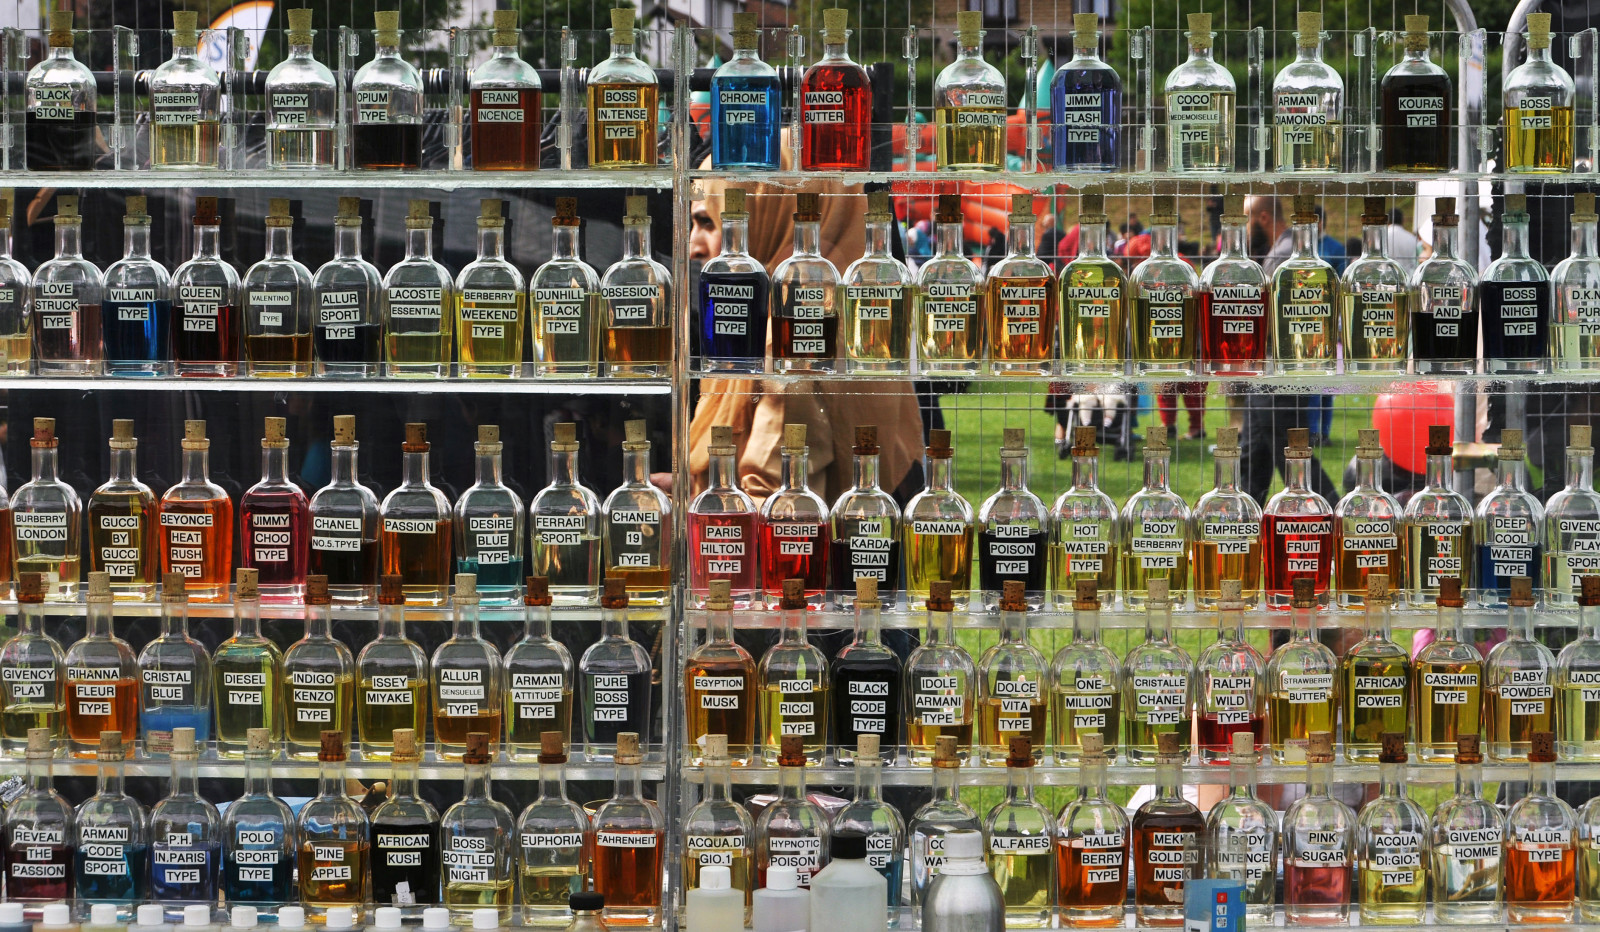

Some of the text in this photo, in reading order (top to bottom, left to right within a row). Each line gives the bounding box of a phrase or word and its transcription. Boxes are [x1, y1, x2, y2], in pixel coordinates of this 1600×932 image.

[36, 91, 70, 100] BLACK
[273, 96, 308, 105] HAPPY
[482, 93, 518, 102] FRANK
[606, 92, 636, 101] BOSS
[721, 93, 765, 103] CHROME
[806, 94, 842, 103] MANGO
[1067, 96, 1100, 105] JIMMY
[1177, 95, 1209, 104] COCO
[1279, 96, 1317, 106] ARMANI
[1400, 99, 1443, 108] KOURAS
[1521, 99, 1550, 109] BOSS
[36, 108, 73, 118] STONE
[479, 111, 523, 121] INCENCE
[805, 112, 843, 121] BUTTER
[1066, 113, 1100, 122] FLASH
[43, 284, 71, 294] LOVE
[182, 289, 220, 299] QUEEN
[389, 289, 440, 299] LACOSTE
[709, 287, 753, 297] ARMANI
[847, 288, 902, 298] ETERNITY
[930, 286, 969, 296] GUILTY
[1214, 288, 1260, 298] VANILLA
[1292, 289, 1321, 299] LADY
[1434, 288, 1459, 298] FIRE
[1505, 289, 1536, 299] BOSS
[111, 291, 152, 300] VILLAIN
[323, 294, 357, 303] ALLUR
[465, 291, 513, 300] BERBERRY
[536, 290, 583, 300] DUNHILL
[795, 290, 823, 300] MISS
[1363, 293, 1392, 303] SEAN
[36, 301, 78, 311] STRUCK
[186, 304, 216, 314] LATIF
[543, 306, 580, 315] BLACK
[716, 305, 747, 315] CODE
[926, 303, 975, 313] INTENCE
[1213, 305, 1263, 315] FANTASY
[1284, 305, 1328, 315] MILLION
[321, 310, 358, 320] SPORT
[462, 310, 517, 320] WEEKEND
[1151, 309, 1182, 318] BOSS
[1363, 310, 1394, 320] JOHN
[1436, 307, 1460, 317] AND
[1502, 306, 1537, 317] NIHGT
[795, 325, 822, 334] DIOR
[1438, 325, 1456, 335] ICE
[16, 514, 65, 523] BURBERRY
[102, 517, 138, 527] GUCCI
[161, 514, 212, 525] BEYONCE
[254, 516, 288, 526] JIMMY
[536, 517, 584, 527] FERRARI
[613, 512, 658, 522] CHANEL
[315, 519, 358, 530] CHANEL
[385, 520, 433, 532] PASSION
[471, 519, 512, 529] DESIRE
[860, 523, 880, 533] KIM
[915, 523, 960, 533] BANANA
[1144, 523, 1176, 533] BODY
[1277, 523, 1331, 533] JAMAICAN
[1356, 523, 1389, 533] COCO
[1496, 519, 1526, 529] DEEP
[18, 528, 65, 539] LONDON
[707, 527, 740, 537] PARIS
[775, 525, 817, 535] DESIRE
[997, 526, 1028, 536] PURE
[1074, 526, 1097, 535] HOT
[1206, 524, 1258, 535] EMPRESS
[1429, 525, 1461, 535] ROCK
[113, 533, 128, 543] BY
[172, 532, 200, 542] HEAT
[255, 533, 289, 543] CHOO
[478, 536, 507, 546] BLUE
[542, 533, 579, 543] SPORT
[628, 533, 640, 542] 19
[1496, 534, 1527, 544] COOL
[702, 544, 742, 554] HILTON
[851, 539, 889, 549] KARDA
[991, 544, 1034, 554] POISON
[1066, 543, 1105, 552] WATER
[1134, 540, 1183, 549] BERBERRY
[1288, 542, 1320, 552] FRUIT
[1344, 539, 1397, 549] CHANNEL
[103, 549, 139, 559] GUCCI
[172, 549, 202, 560] RUSH
[852, 554, 887, 564] SHIAN
[1492, 549, 1531, 559] WATER
[1429, 559, 1460, 569] ROSE
[3, 670, 54, 679] GIVENCY
[69, 669, 118, 679] RIHANNA
[143, 672, 190, 682] CRISTAL
[225, 674, 265, 684] DIESEL
[294, 673, 334, 684] INDIGO
[442, 671, 479, 681] ALLUR
[1514, 671, 1543, 682] BABY
[373, 677, 406, 687] ISSEY
[516, 675, 560, 686] ARMANI
[595, 677, 627, 687] PURE
[695, 679, 742, 689] EGYPTION
[922, 678, 957, 688] IDOLE
[1077, 679, 1102, 689] ONE
[1135, 677, 1185, 687] CRISTALLE
[1213, 678, 1251, 689] RALPH
[1284, 676, 1332, 686] STRAWBERRY
[1425, 674, 1477, 685] CASHMIR
[14, 686, 42, 696] PLAY
[78, 686, 115, 696] FLEUR
[781, 681, 812, 691] RICCI
[849, 683, 887, 693] BLACK
[997, 682, 1036, 692] DOLCE
[153, 688, 181, 698] BLUE
[294, 691, 333, 701] KENZO
[515, 689, 560, 700] ATTITUDE
[1289, 691, 1326, 701] BUTTER
[1502, 686, 1551, 697] POWDER
[368, 693, 410, 703] MIYAKE
[595, 693, 627, 703] BOSS
[703, 697, 736, 707] MUSK
[916, 696, 961, 706] ARMANI
[1066, 697, 1111, 707] MILLION
[1139, 694, 1185, 705] CHANEL
[1215, 695, 1245, 705] WILD
[1359, 696, 1401, 706] POWER
[852, 702, 884, 712] CODE
[1003, 701, 1028, 711] VITA
[15, 831, 61, 841] REVEAL
[83, 829, 127, 839] ARMANI
[241, 832, 273, 842] POLO
[1309, 833, 1336, 843] PINK
[1450, 831, 1500, 843] GIVENCY
[378, 836, 429, 846] AFRICAN
[453, 839, 484, 849] BOSS
[521, 834, 582, 846] EUPHORIA
[597, 834, 656, 845] FAHRENHEIT
[1084, 835, 1120, 846] HALLE
[1377, 836, 1417, 847] ACQUA
[28, 848, 52, 858] THE
[88, 846, 121, 857] CODE
[316, 849, 343, 859] PINE
[1455, 847, 1498, 858] HOMME
[237, 852, 277, 862] SPORT
[388, 854, 420, 864] KUSH
[1082, 853, 1122, 864] BERRY
[1303, 852, 1343, 862] SUGAR
[13, 865, 64, 876] PASSION
[86, 863, 125, 873] SPORT
[312, 868, 348, 879] APPLE
[451, 870, 485, 881] NIGHT
